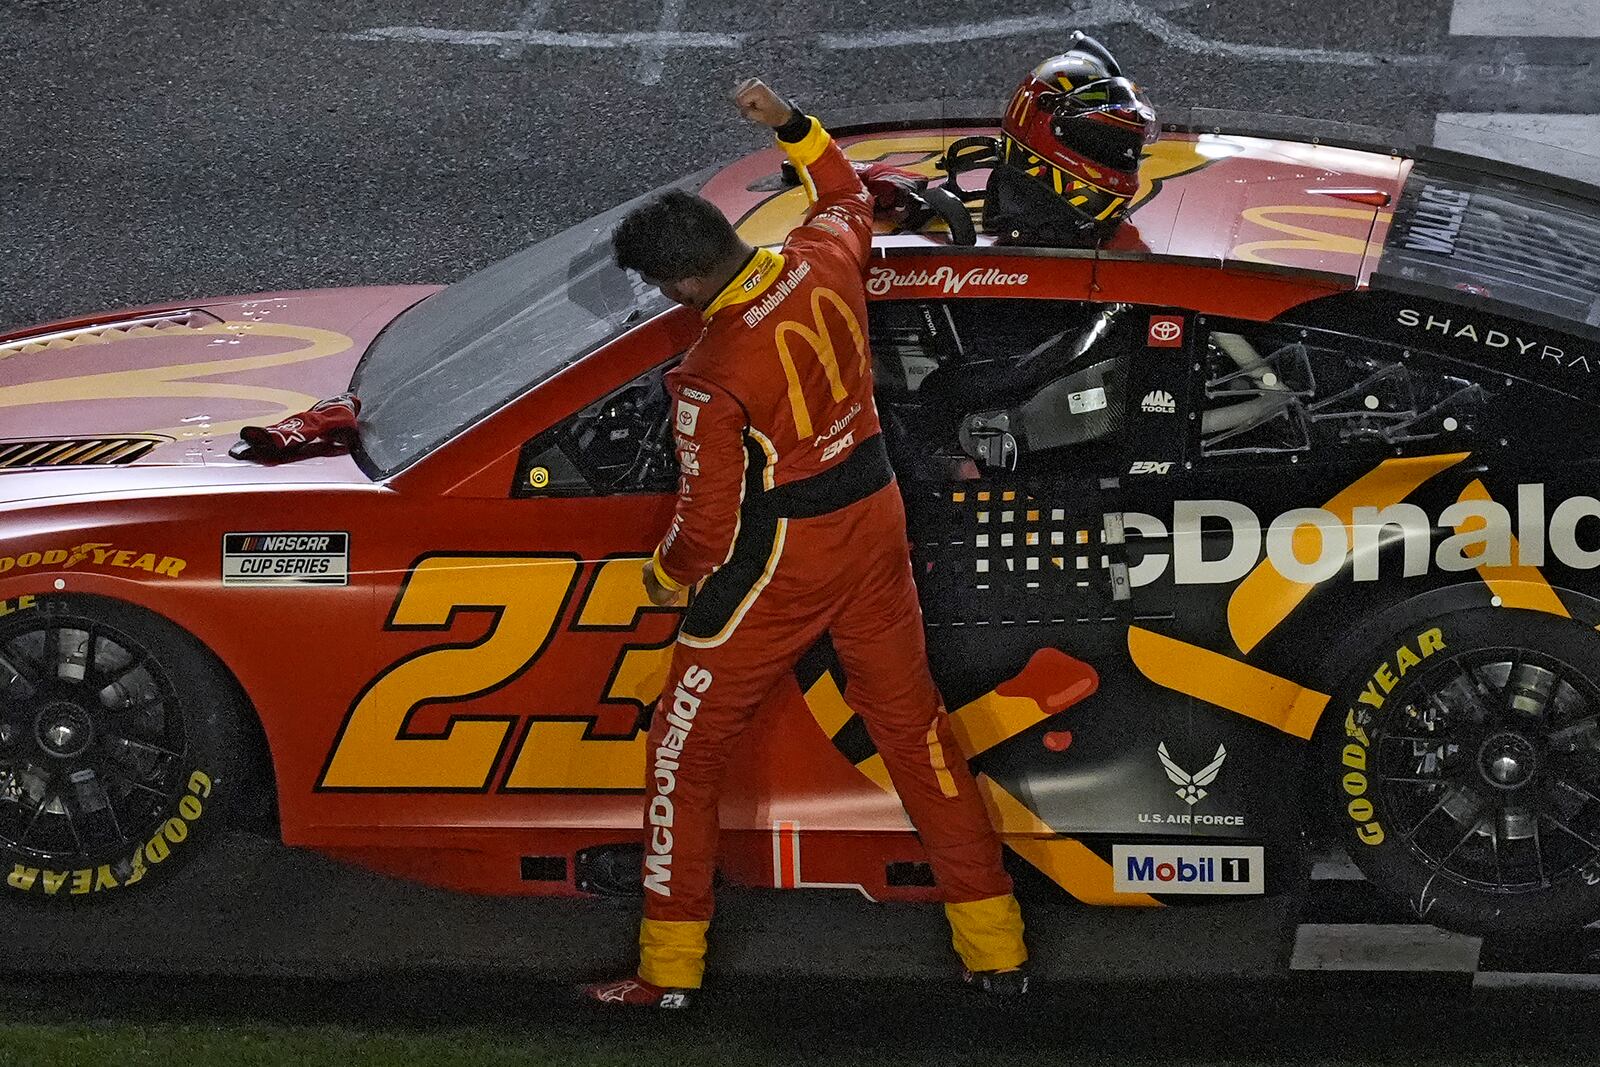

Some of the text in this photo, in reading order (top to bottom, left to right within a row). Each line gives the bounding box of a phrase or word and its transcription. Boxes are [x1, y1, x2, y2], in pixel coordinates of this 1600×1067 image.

[742, 260, 811, 329] @BubbaWallace
[682, 387, 711, 403] NASCAR
[1141, 390, 1176, 407] MAC
[263, 537, 330, 551] NASCAR
[240, 559, 330, 573] CUP SERIES
[313, 550, 690, 794] 23
[1138, 813, 1245, 826] U.S. AIR FORCE
[1127, 856, 1240, 882] Mobil 1
